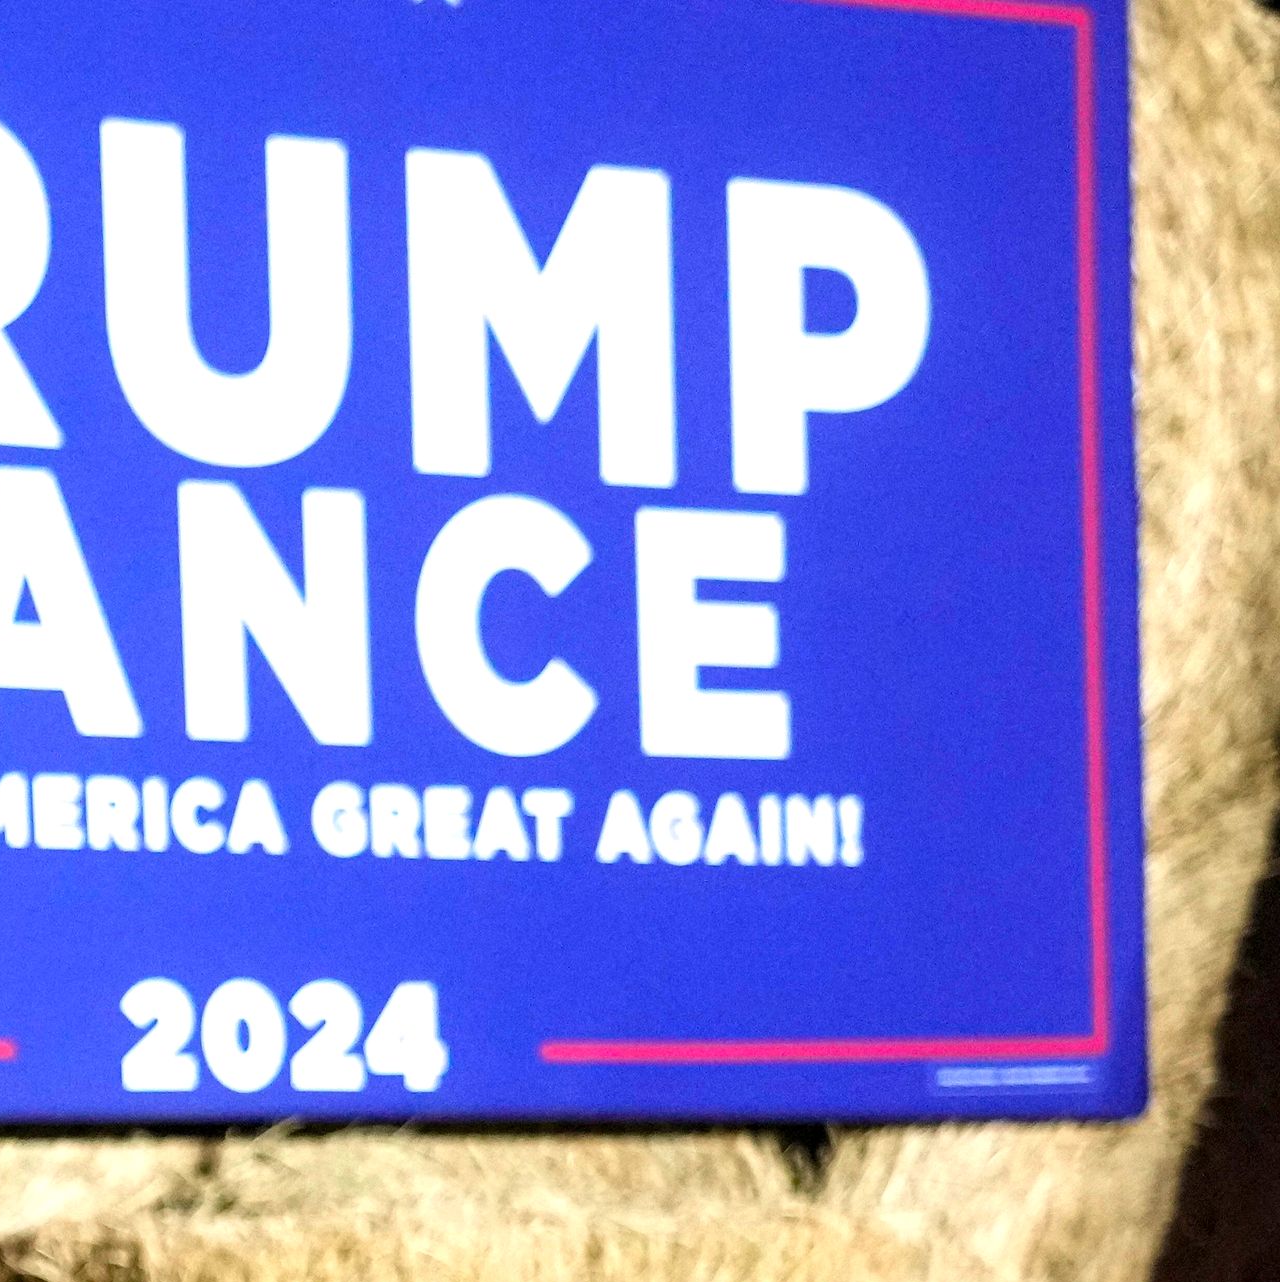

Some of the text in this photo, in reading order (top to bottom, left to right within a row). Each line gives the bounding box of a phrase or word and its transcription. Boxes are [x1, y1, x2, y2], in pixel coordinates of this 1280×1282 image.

[310, 780, 574, 863] GREAT
[595, 789, 864, 868] AGAIN!
[119, 976, 450, 1093] 2024
